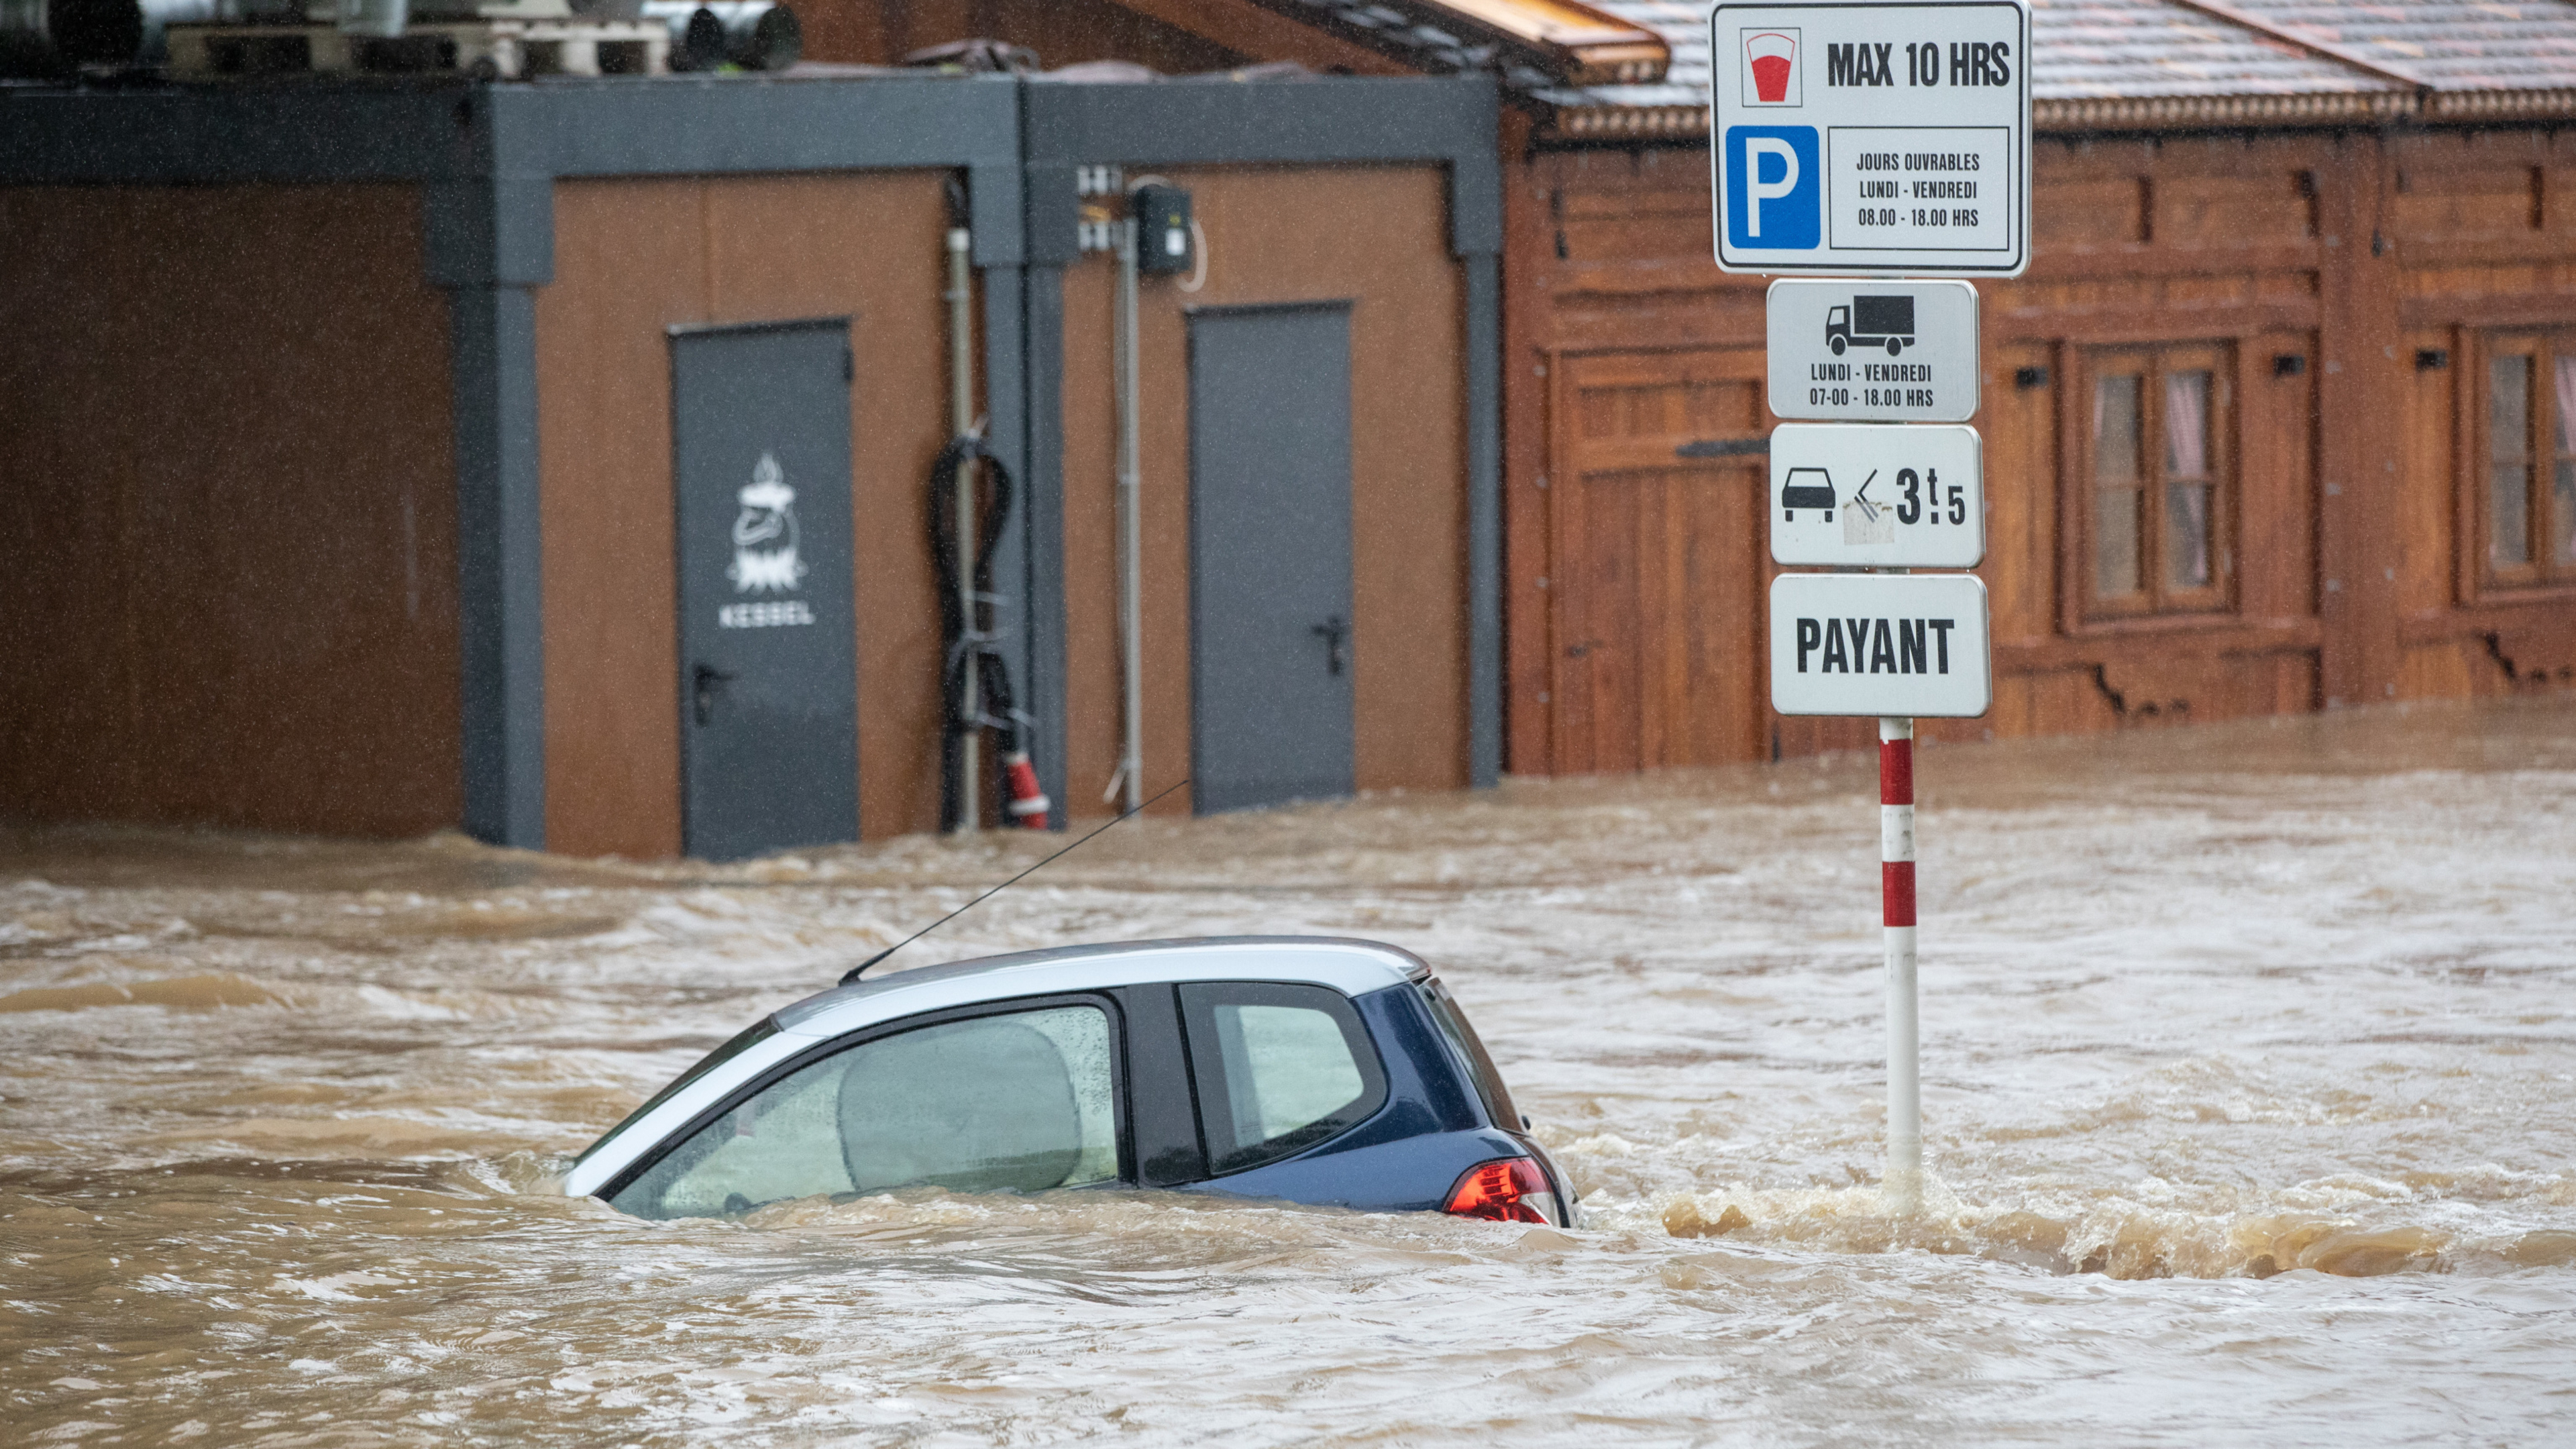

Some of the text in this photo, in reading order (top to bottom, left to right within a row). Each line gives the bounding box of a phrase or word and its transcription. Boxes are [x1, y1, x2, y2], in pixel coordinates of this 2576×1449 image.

[1827, 42, 2010, 87] MAX 10 HRS
[1856, 153, 1980, 171] JOURS OUVRABLES
[1746, 137, 1799, 237] P
[1860, 181, 1898, 199] LUNDI
[1913, 181, 1977, 199] VENDREDI
[1858, 208, 1896, 226] 08.00
[1911, 209, 1947, 226] 18.00
[1953, 209, 1978, 227] HRS
[1811, 363, 1851, 381] LUNDI
[1864, 364, 1931, 382] VENDREDI
[1864, 388, 1901, 407] 18.00
[1907, 389, 1933, 407] HRS
[1796, 618, 1955, 674] PAYANT
